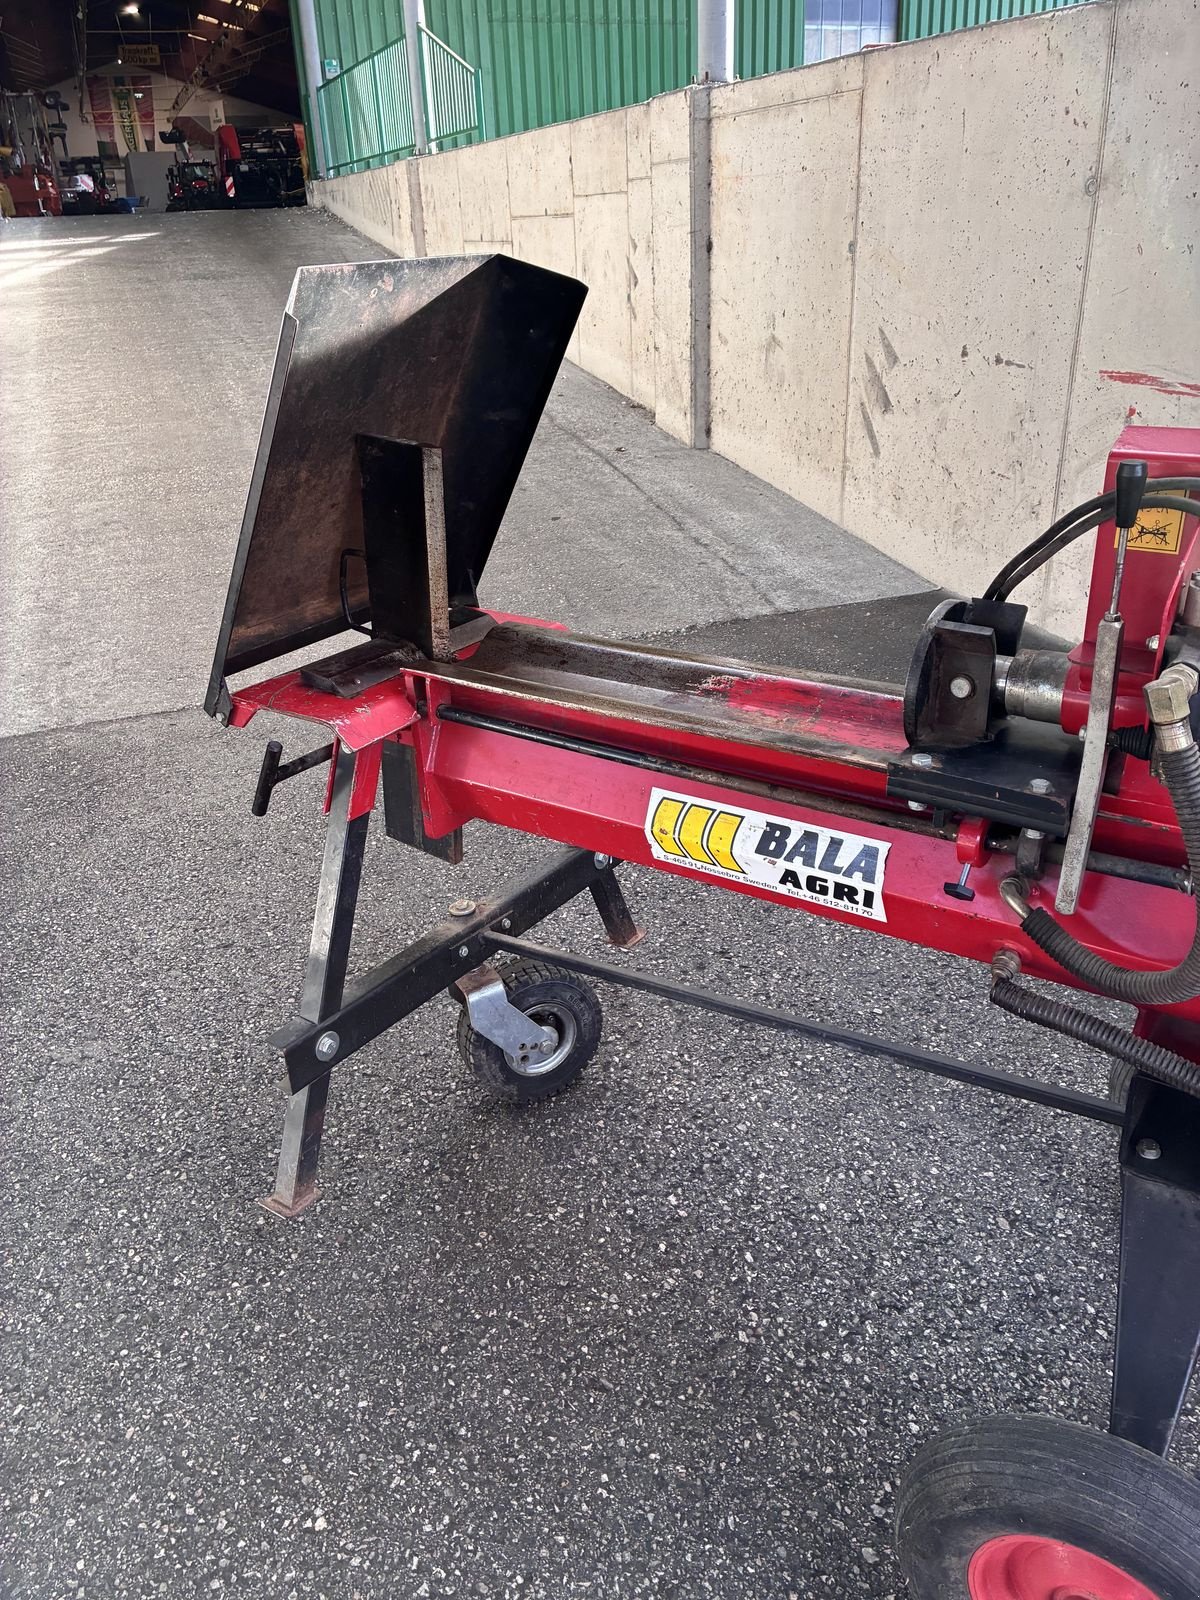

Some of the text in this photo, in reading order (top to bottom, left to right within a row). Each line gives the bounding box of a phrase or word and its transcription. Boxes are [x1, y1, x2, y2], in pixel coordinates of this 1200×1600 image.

[754, 821, 880, 885] BALA
[742, 876, 778, 891] Sweden
[779, 868, 875, 910] AGRI
